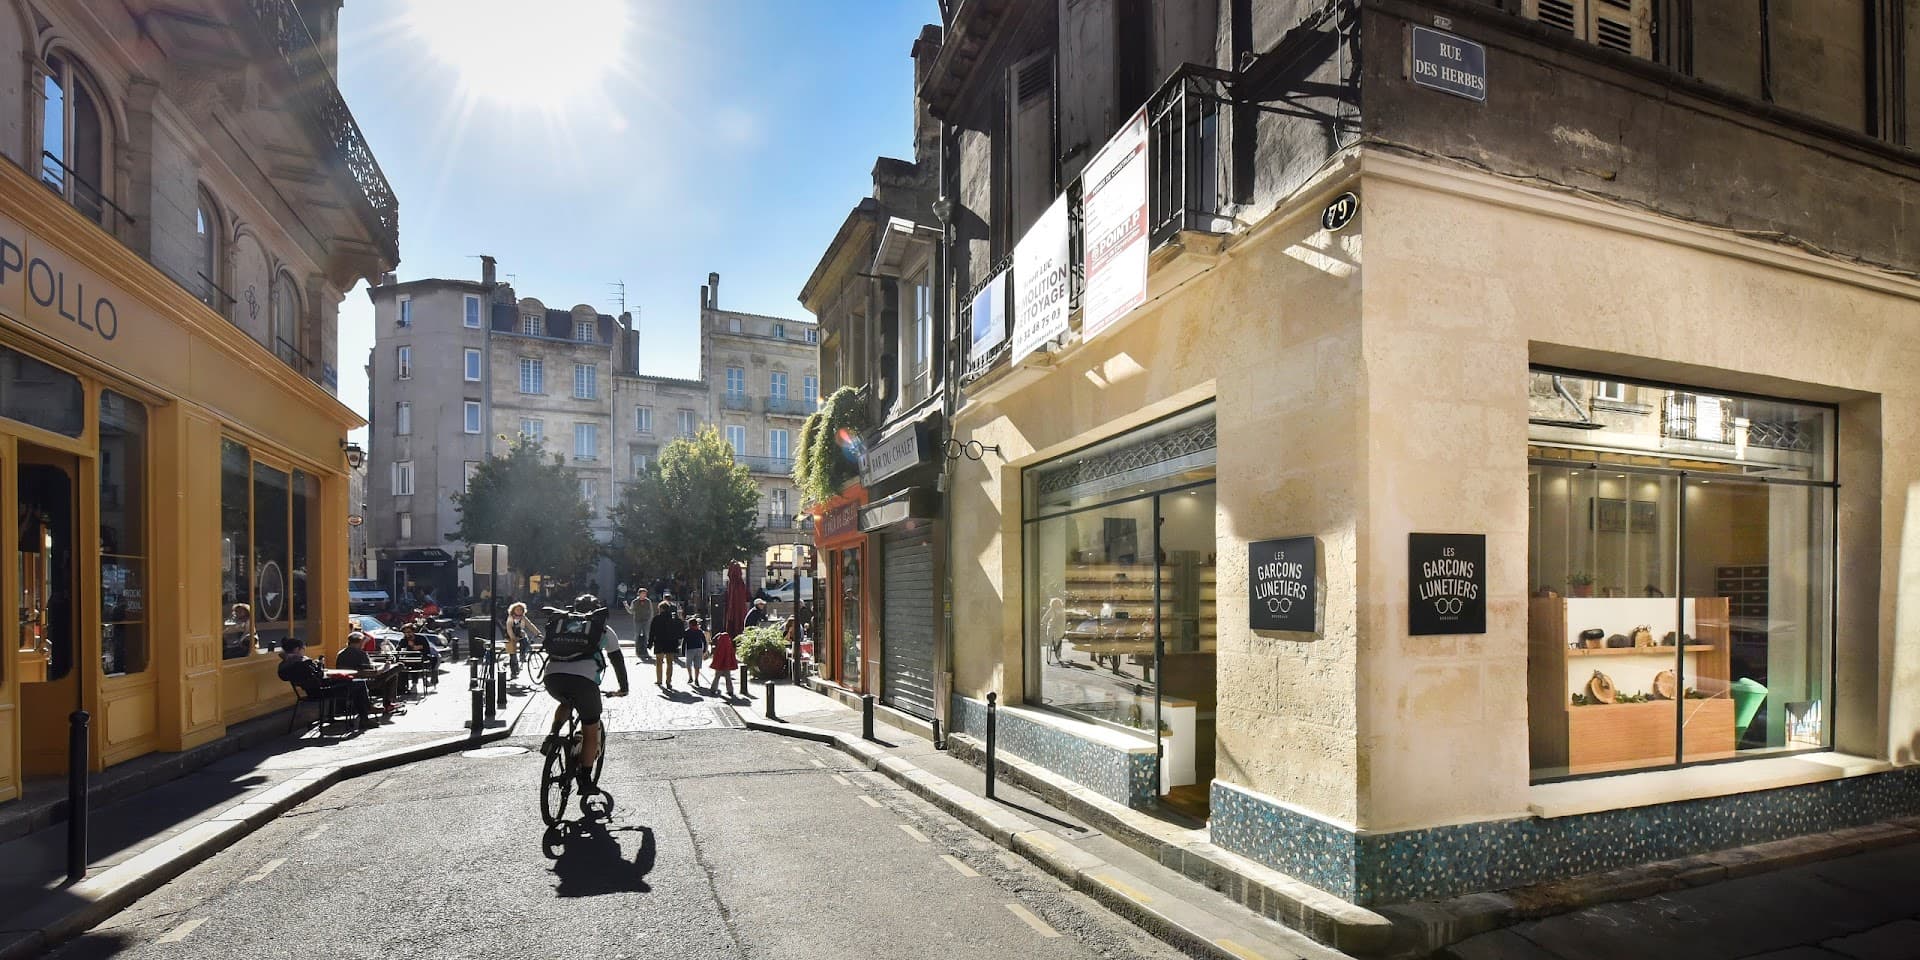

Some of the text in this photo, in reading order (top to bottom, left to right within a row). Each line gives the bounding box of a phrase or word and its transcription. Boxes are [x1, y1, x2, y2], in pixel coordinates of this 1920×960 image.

[1440, 43, 1462, 61] RUE
[1416, 59, 1483, 90] DES HERBES
[1328, 199, 1347, 226] 79
[0, 236, 117, 341] POLLO
[1016, 263, 1067, 309] MOLITION
[1016, 283, 1065, 329] ETTOYAGE
[1274, 551, 1285, 561] LES
[1443, 547, 1455, 557] LES
[1257, 562, 1303, 580] GARÇONS
[1423, 559, 1474, 578] GARÇONS
[1255, 580, 1307, 600] LUNETIERS
[1419, 578, 1478, 600] LUNETIERS
